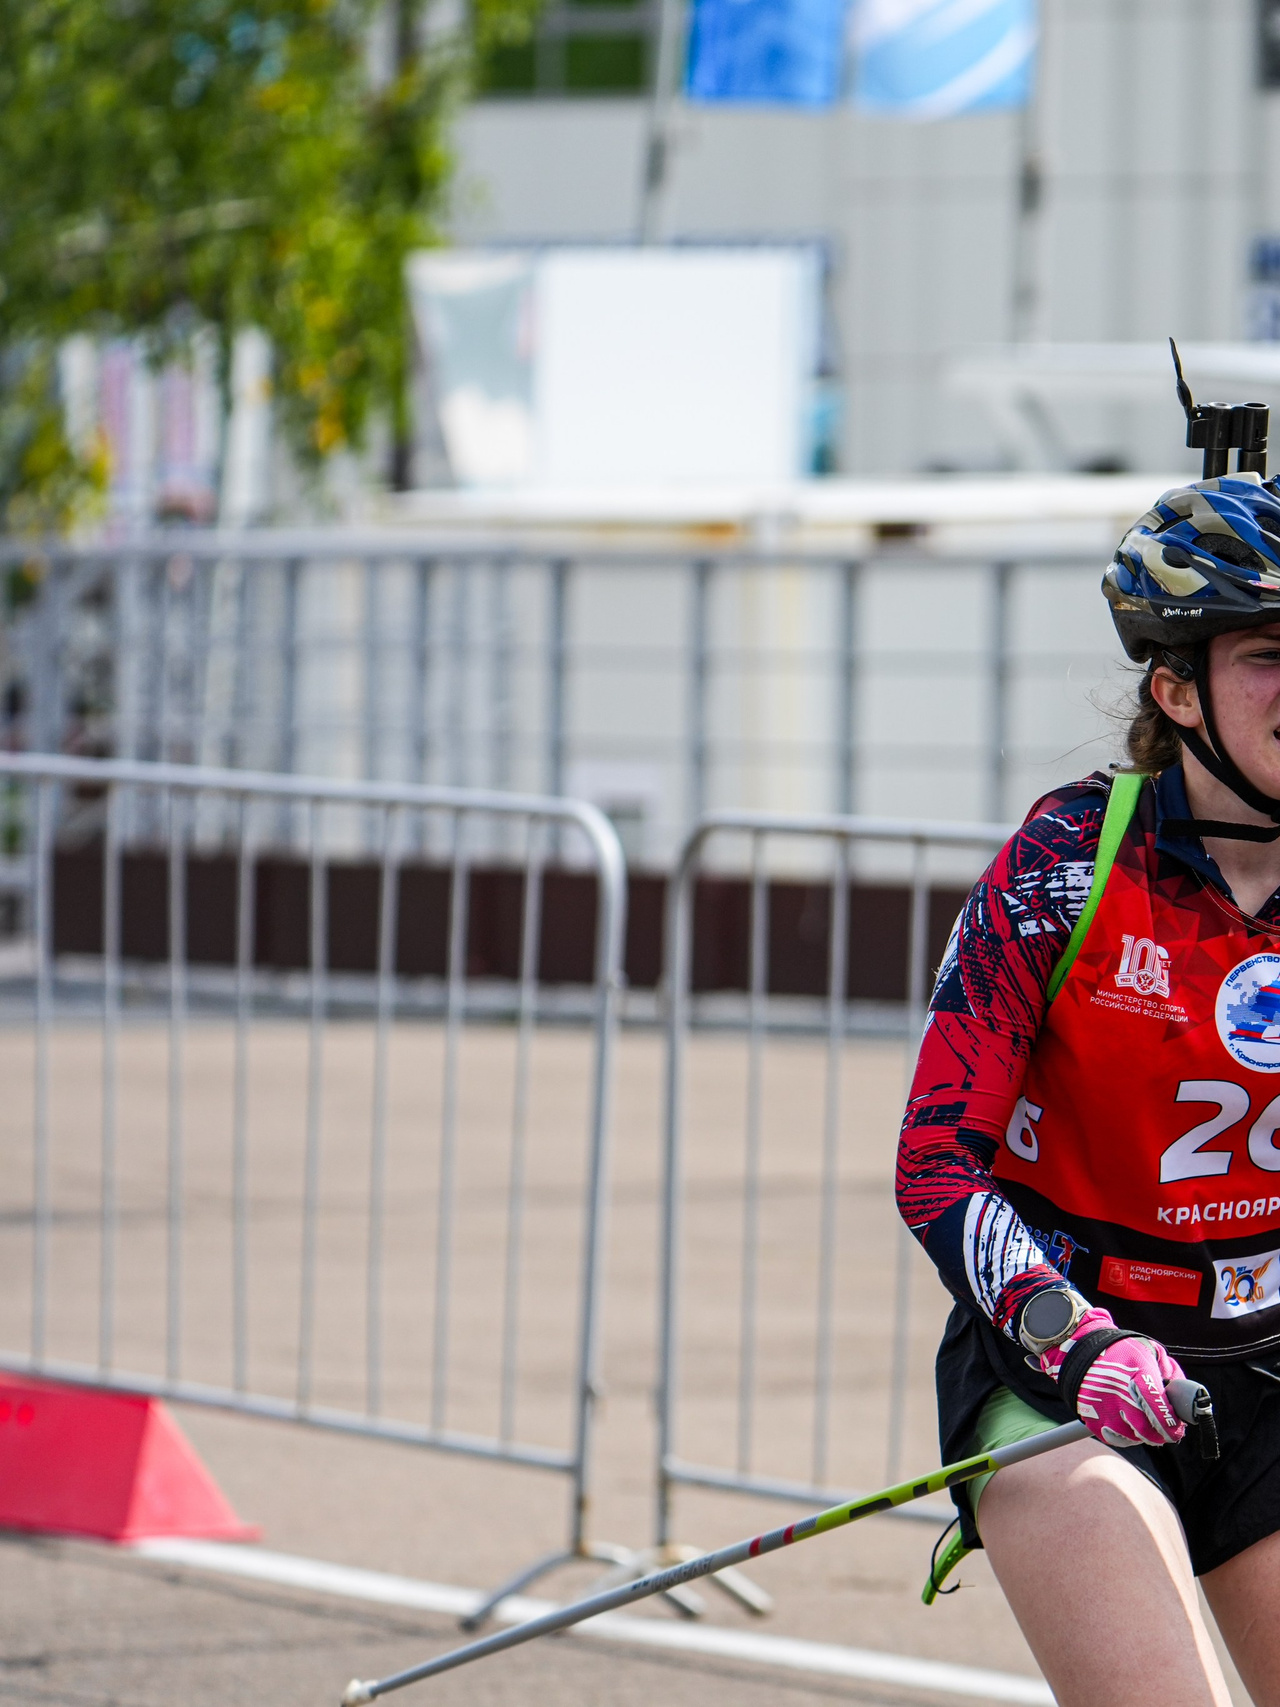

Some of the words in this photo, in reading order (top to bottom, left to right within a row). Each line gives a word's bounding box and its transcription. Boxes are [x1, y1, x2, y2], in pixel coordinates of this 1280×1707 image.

[1225, 955, 1280, 987] ПЕРВЕНСТВО
[1090, 996, 1141, 1014] РОССИЙСКОЙ
[1142, 1008, 1189, 1023] ФЕДЕРАЦИИ
[1096, 989, 1158, 1009] МИНИСТЕРСТВО
[1159, 1003, 1186, 1015] СПОРТА
[1129, 1264, 1197, 1280] КРАСНОЯРСКИЙ
[1129, 1272, 1151, 1282] КРАЙ
[1141, 1374, 1160, 1395] SKI
[1154, 1395, 1177, 1427] TIME
